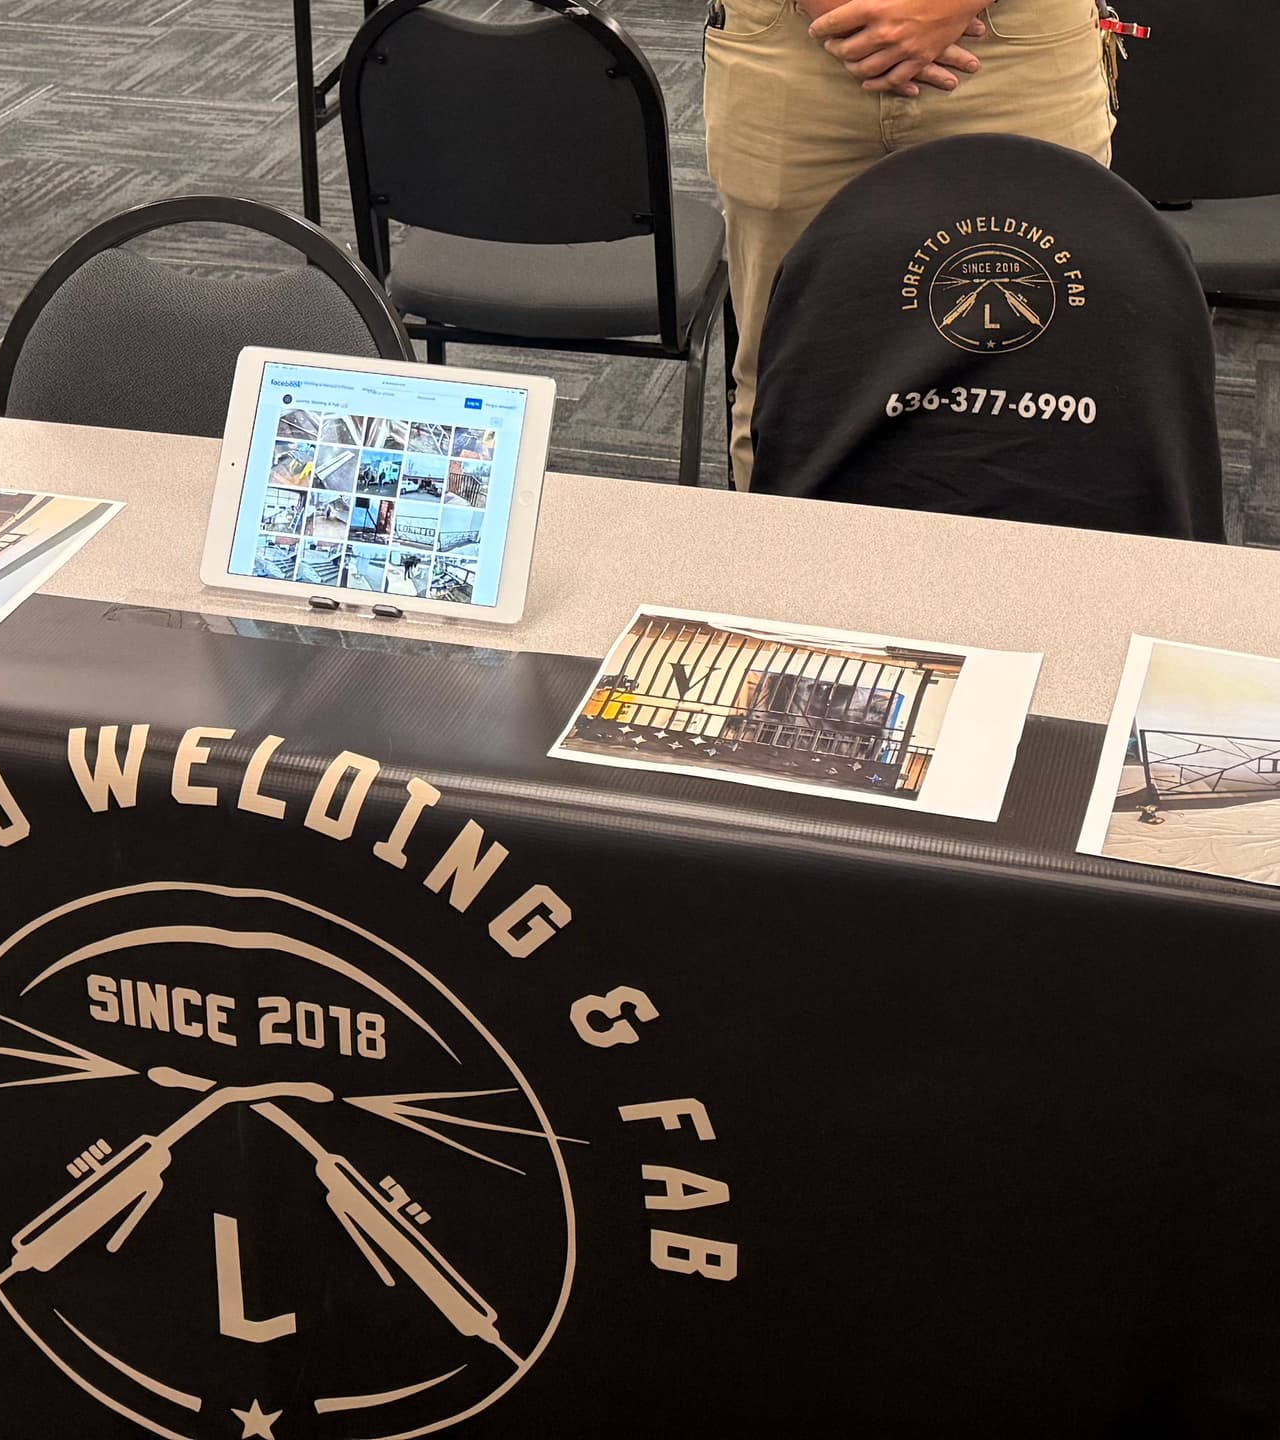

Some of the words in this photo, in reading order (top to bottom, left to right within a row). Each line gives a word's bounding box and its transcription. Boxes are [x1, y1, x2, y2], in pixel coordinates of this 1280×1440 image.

[901, 230, 952, 311] LORETTO
[955, 216, 1055, 250] WELDING
[1054, 251, 1072, 265] &
[1063, 270, 1086, 308] FAB
[962, 262, 991, 274] SINCE
[984, 303, 1001, 329] L
[885, 386, 1097, 425] 636-377-6990
[66, 722, 573, 959] WELDING
[569, 984, 660, 1048] &
[618, 1097, 738, 1282] FAB
[87, 972, 238, 1047] SINCE
[256, 994, 388, 1061] 2018
[212, 1211, 297, 1344] L
